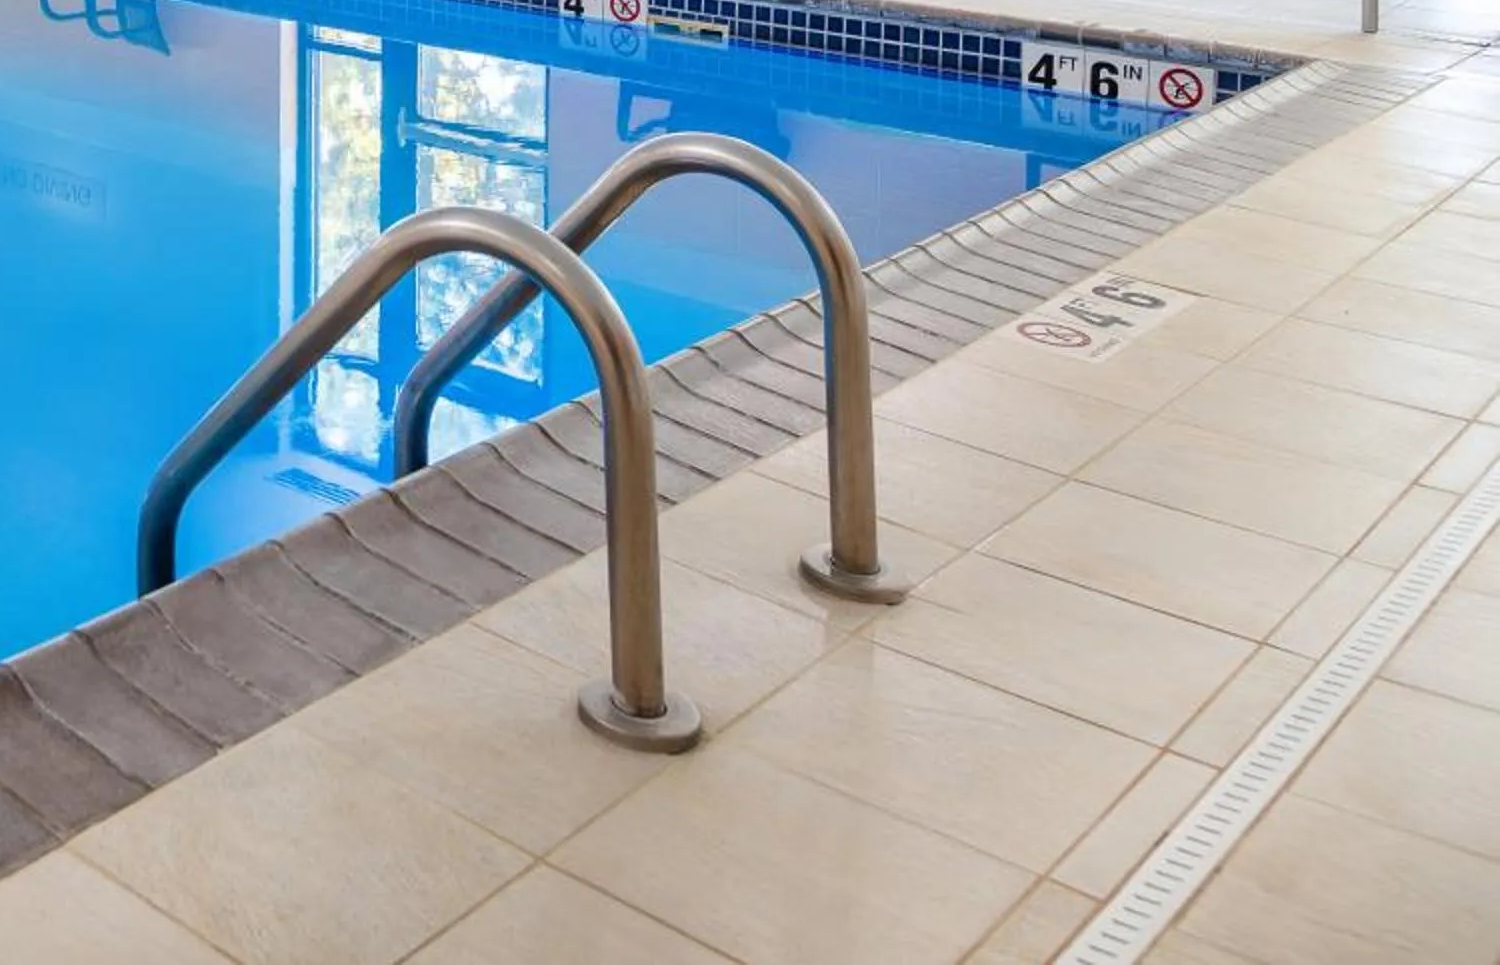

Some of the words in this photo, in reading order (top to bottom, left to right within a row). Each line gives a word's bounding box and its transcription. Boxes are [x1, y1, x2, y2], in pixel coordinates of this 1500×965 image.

[1027, 53, 1057, 90] 4
[1059, 55, 1078, 71] FT
[1090, 60, 1119, 99] 6
[1123, 64, 1143, 82] IN
[1092, 285, 1166, 309] 6
[1060, 304, 1134, 328] 4
